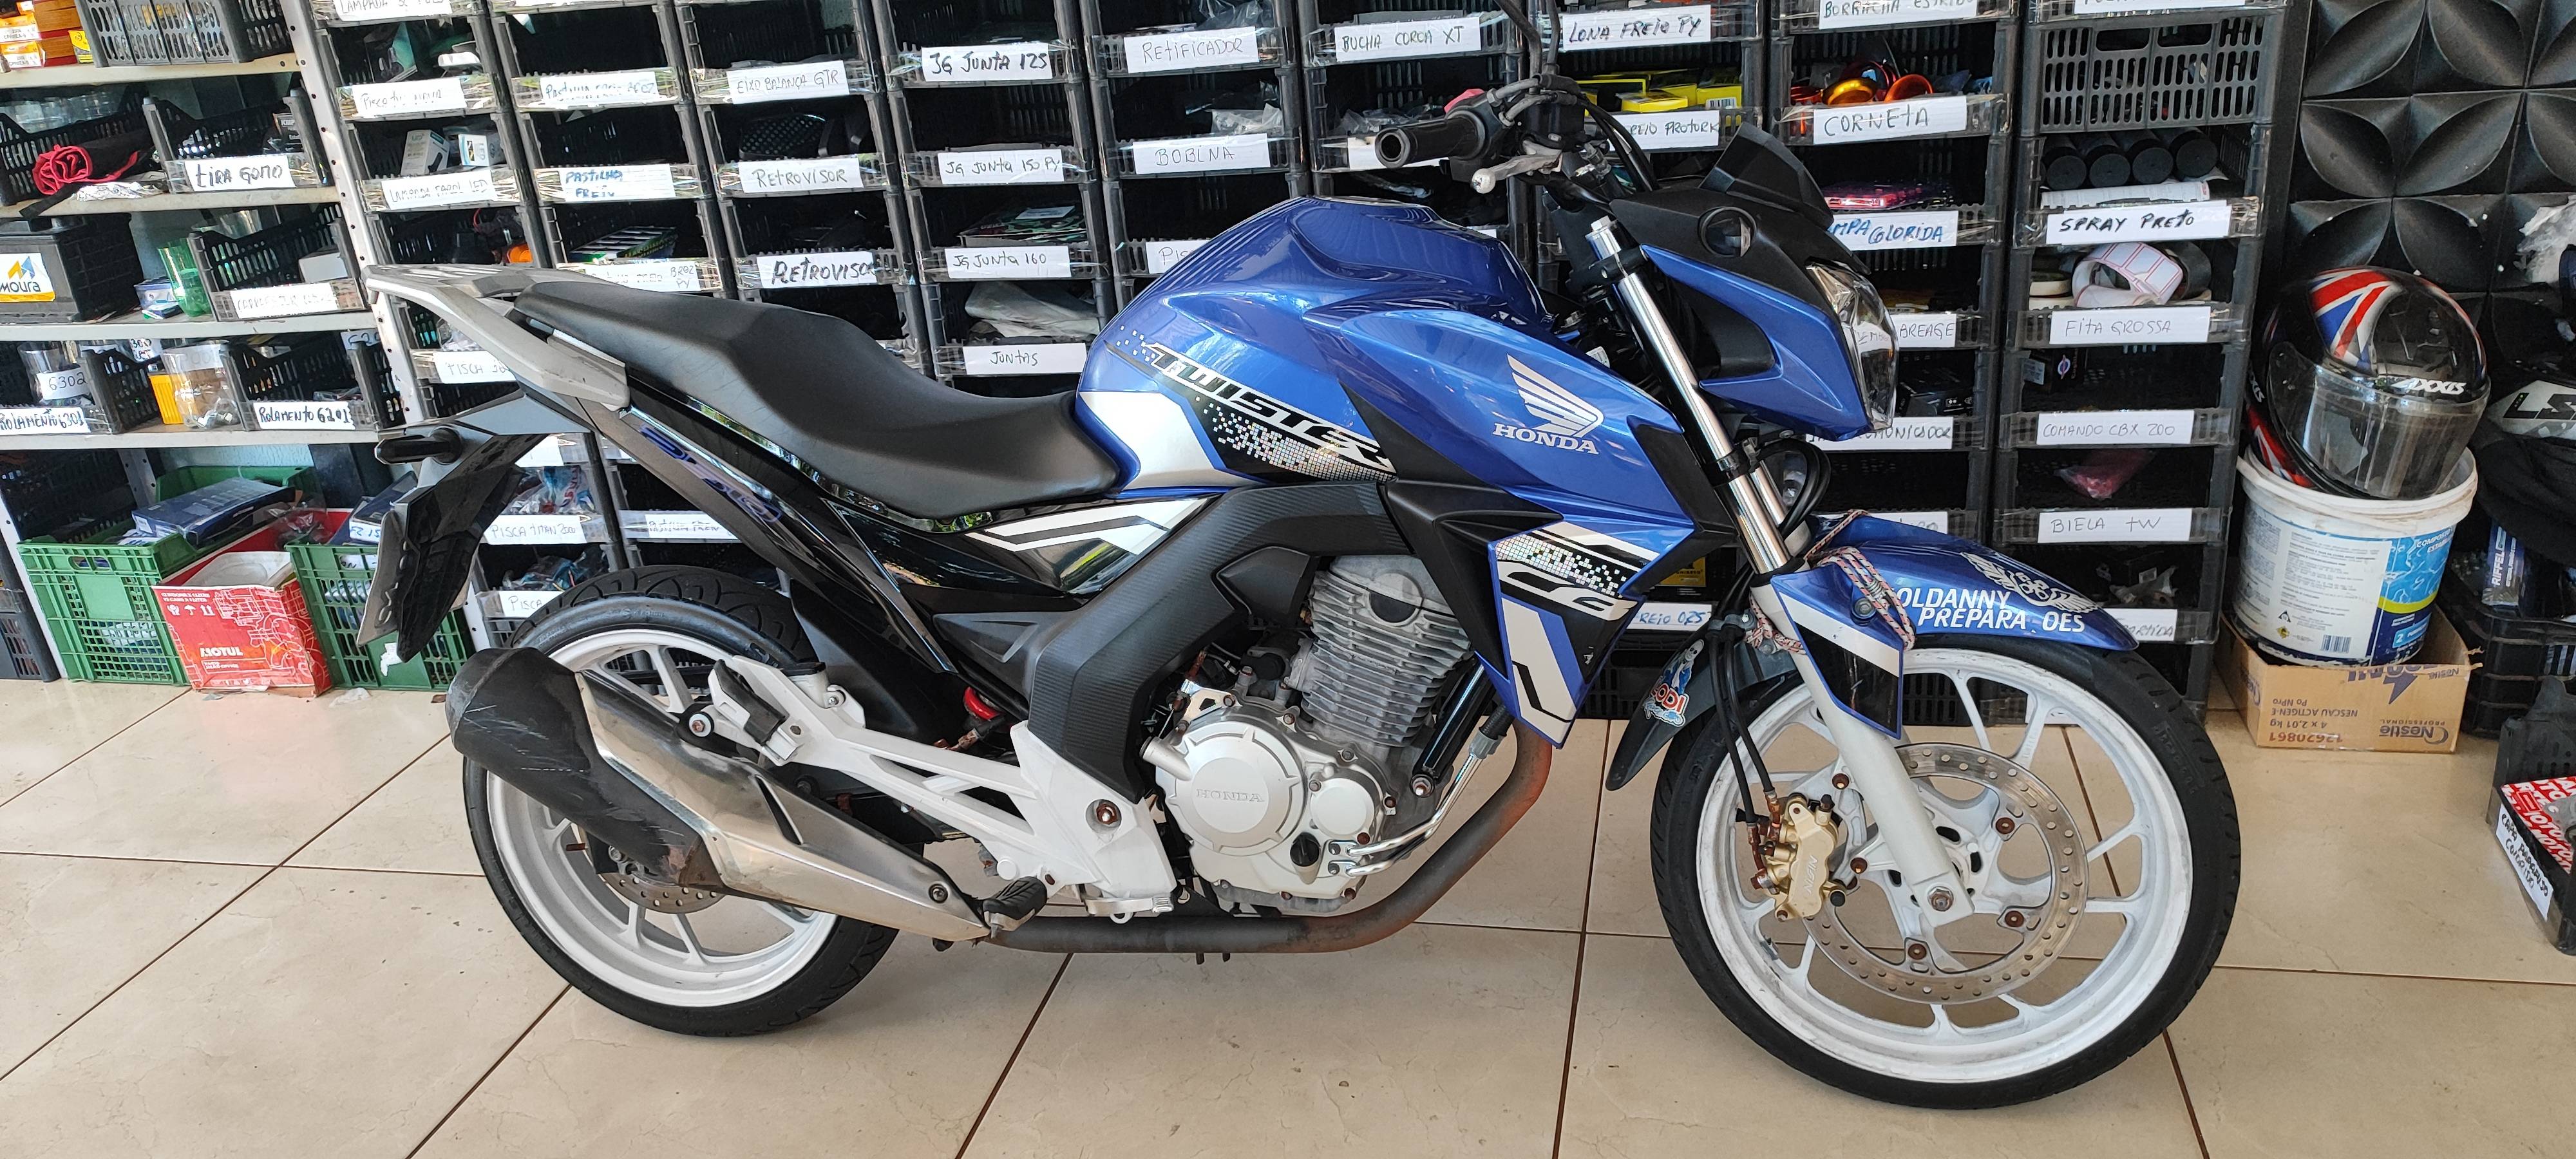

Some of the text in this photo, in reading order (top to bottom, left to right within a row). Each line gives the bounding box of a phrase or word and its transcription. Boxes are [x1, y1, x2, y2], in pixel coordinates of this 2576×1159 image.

[1443, 25, 1464, 44] XT
[1020, 53, 1047, 70] 125
[814, 69, 839, 88] GTR
[2058, 216, 2128, 232] SPRAY
[1026, 253, 1047, 265] 160
[2110, 319, 2172, 335] GROSSA
[2390, 376, 2467, 395] AXXIS
[2503, 392, 2576, 420] LS
[2043, 422, 2103, 437] COMANDO
[2108, 422, 2139, 437] CBX
[1492, 422, 1600, 455] HONDA
[2050, 517, 2106, 534] BIELA
[2490, 549, 2506, 587] RIFFEL
[508, 596, 543, 610] PISCA
[1900, 587, 2011, 610] OLDANNY
[2320, 708, 2358, 717] NESCAU
[2269, 719, 2283, 729] kg
[1196, 788, 1265, 803] HONDA
